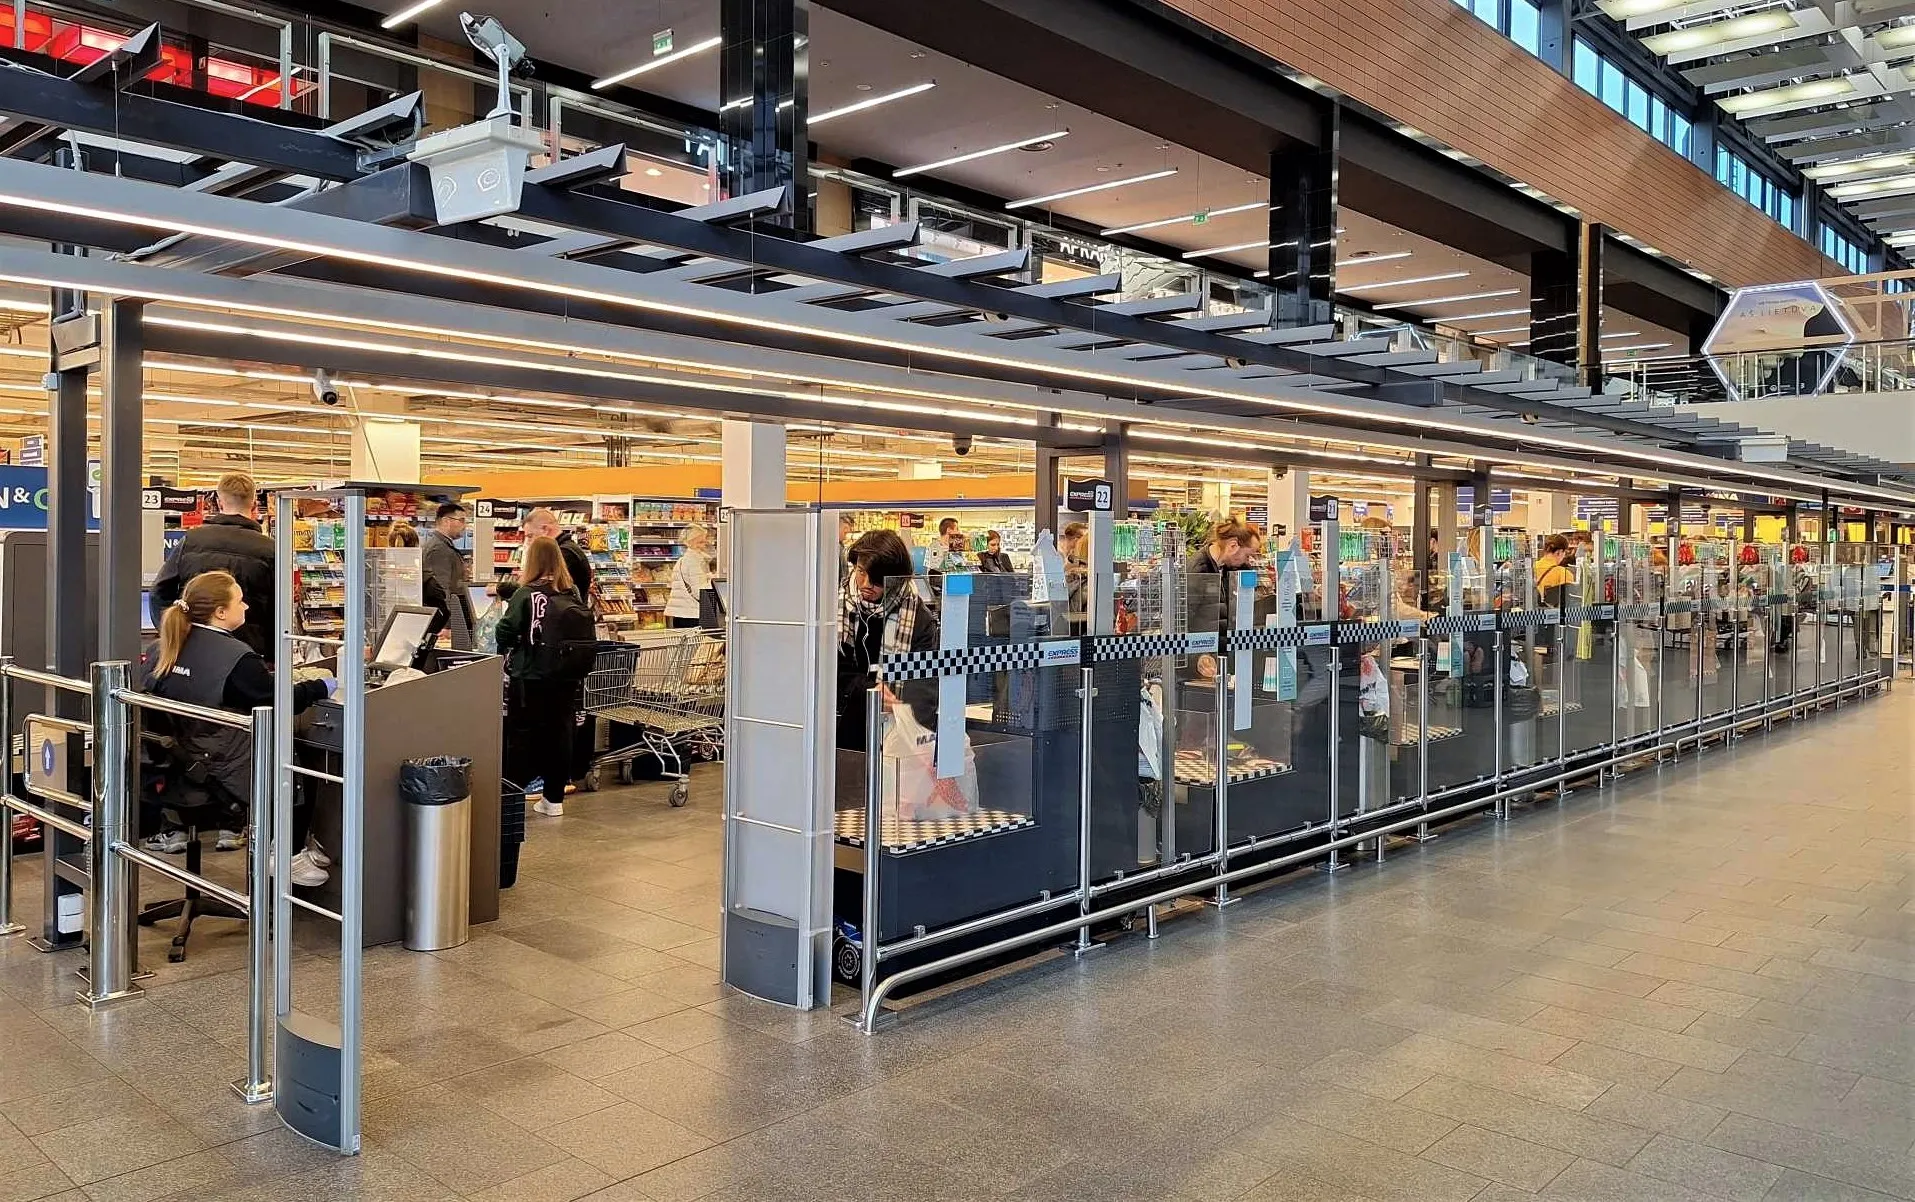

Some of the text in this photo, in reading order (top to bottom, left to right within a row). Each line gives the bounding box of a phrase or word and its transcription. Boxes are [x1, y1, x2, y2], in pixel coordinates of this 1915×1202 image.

[13, 486, 30, 504] &
[144, 494, 159, 504] 23
[1097, 490, 1108, 503] 22
